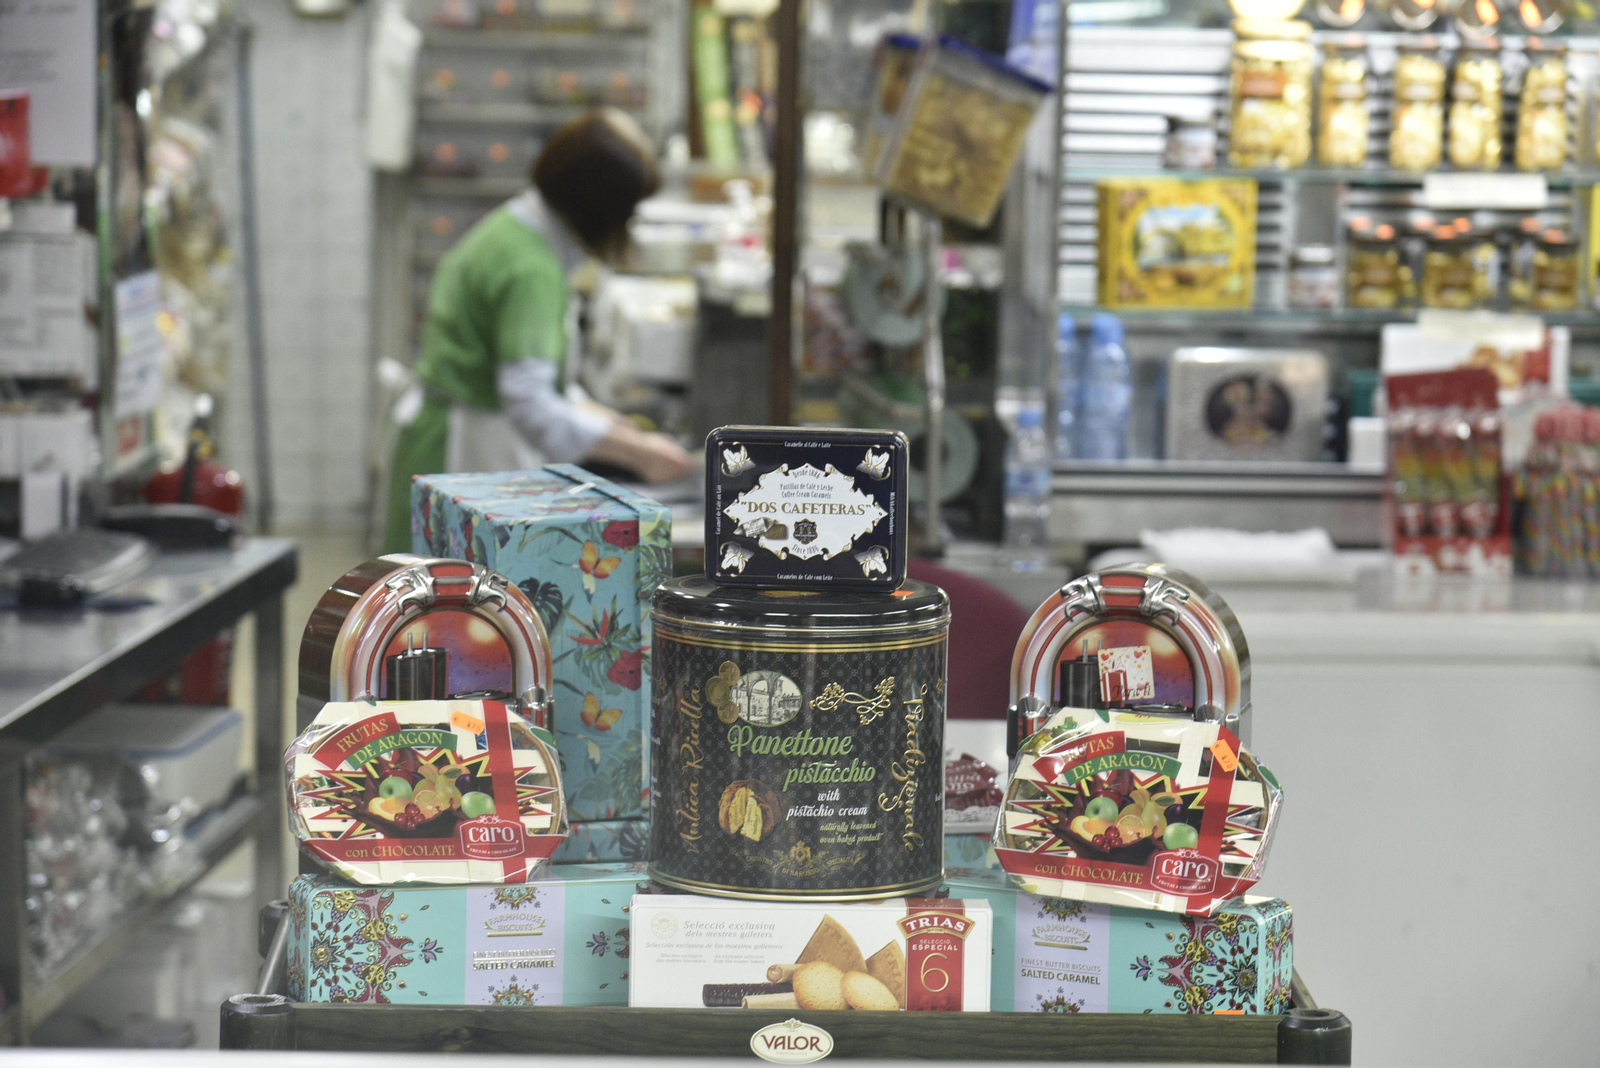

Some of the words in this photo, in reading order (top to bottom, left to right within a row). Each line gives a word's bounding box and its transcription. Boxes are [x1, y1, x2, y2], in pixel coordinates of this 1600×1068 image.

[792, 470, 808, 478] Desde
[809, 469, 821, 479] 1886
[792, 544, 806, 554] Since
[336, 718, 389, 753] FRUTAS
[727, 724, 854, 757] Panettone
[353, 746, 374, 766] DE
[377, 731, 443, 751] ARAGON
[1059, 736, 1115, 766] FRUTAS
[782, 758, 876, 792] pistacchio
[1073, 764, 1093, 781] DE
[1096, 753, 1167, 772] ARAGON
[818, 788, 840, 801] with
[786, 802, 834, 820] pistachio
[838, 807, 868, 816] cream
[468, 826, 514, 842] caro
[820, 822, 848, 834] naturally
[850, 821, 877, 830] leavened
[836, 834, 856, 845] baked
[856, 833, 884, 845] product
[345, 848, 368, 858] con
[372, 844, 456, 857] CHOCOLATE
[1034, 862, 1058, 876] con
[1061, 864, 1144, 886] CHOCOLATE
[1162, 858, 1209, 879] caro
[489, 912, 542, 925] FARMHOUSE
[683, 920, 725, 930] Selecció
[728, 922, 775, 930] exclusiva
[906, 916, 966, 932] TRIAS
[1036, 923, 1088, 938] FARMHOUSE
[1045, 934, 1079, 944] BISCUITS
[472, 960, 508, 971] SALTED
[510, 959, 556, 970] CARAMEL
[921, 952, 949, 992] 6
[1045, 960, 1070, 968] BUTTER
[1072, 963, 1101, 972] BISCUITS
[1021, 968, 1055, 980] SALTED
[1056, 972, 1100, 985] CARAMEL
[760, 1034, 824, 1052] VALOR
